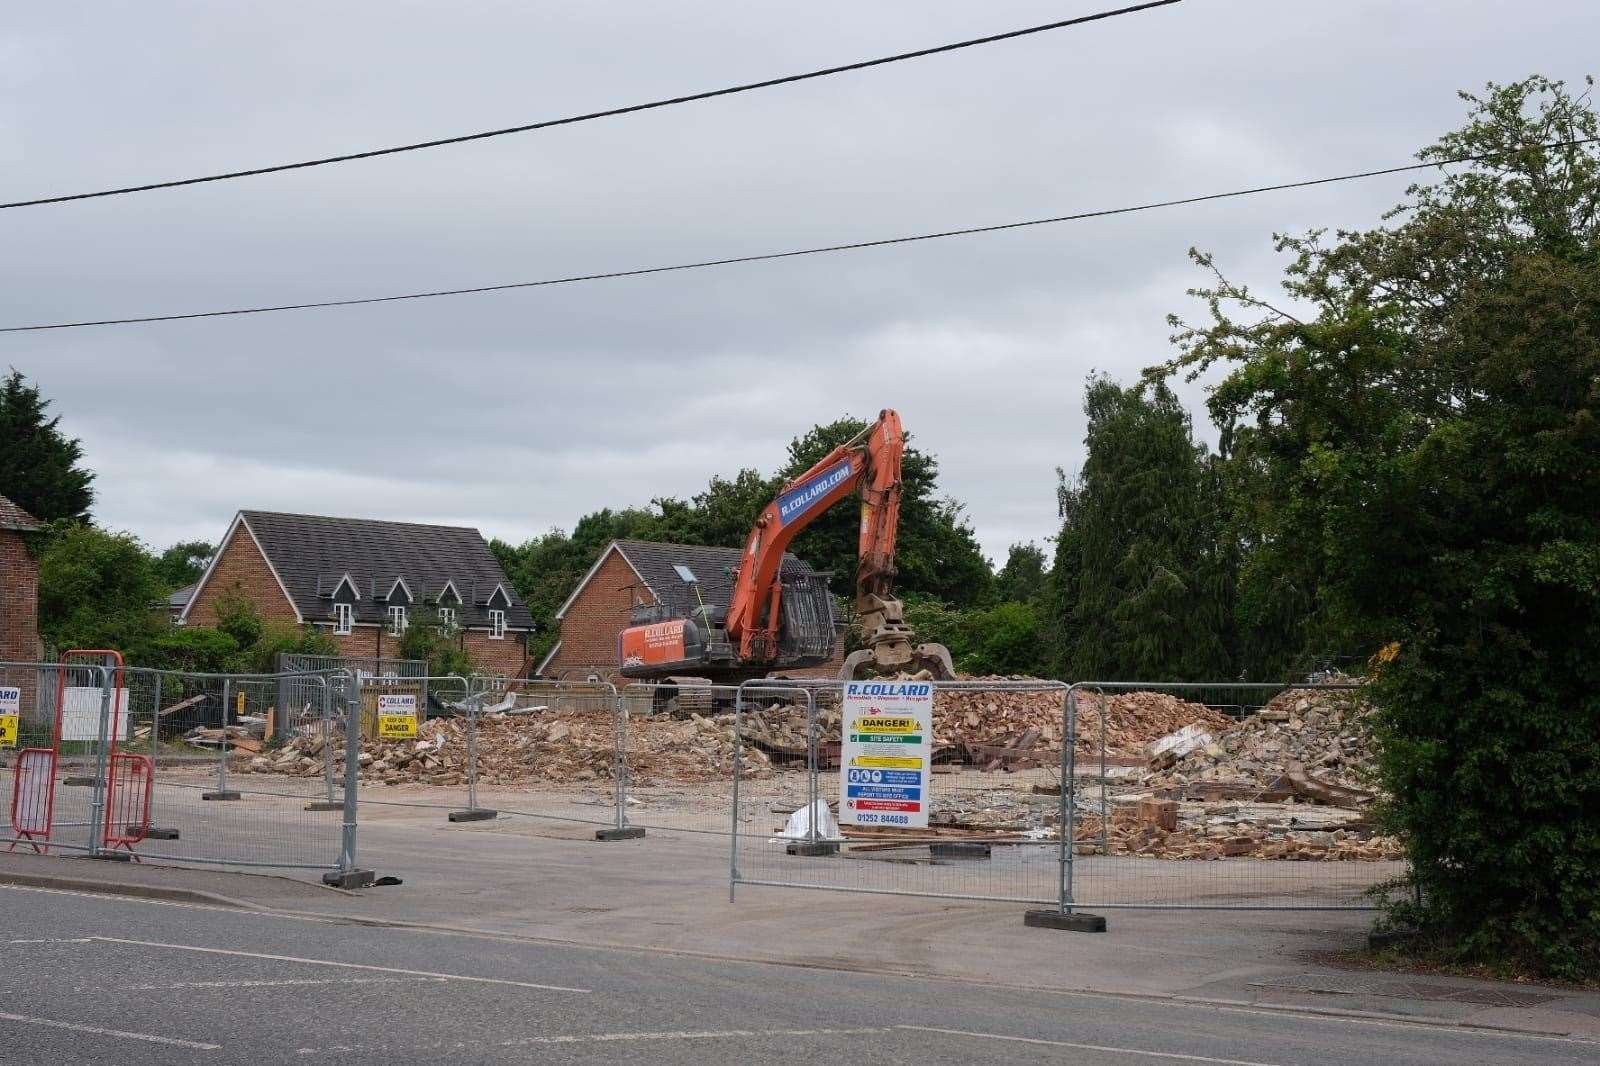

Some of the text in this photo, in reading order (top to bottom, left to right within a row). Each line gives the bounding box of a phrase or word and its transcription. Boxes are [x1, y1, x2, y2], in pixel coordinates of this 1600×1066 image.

[781, 466, 849, 516] R.COLLARD.COM
[847, 684, 930, 696] R.COLLARD
[862, 719, 910, 728] DANGER!
[857, 813, 878, 823] 01252
